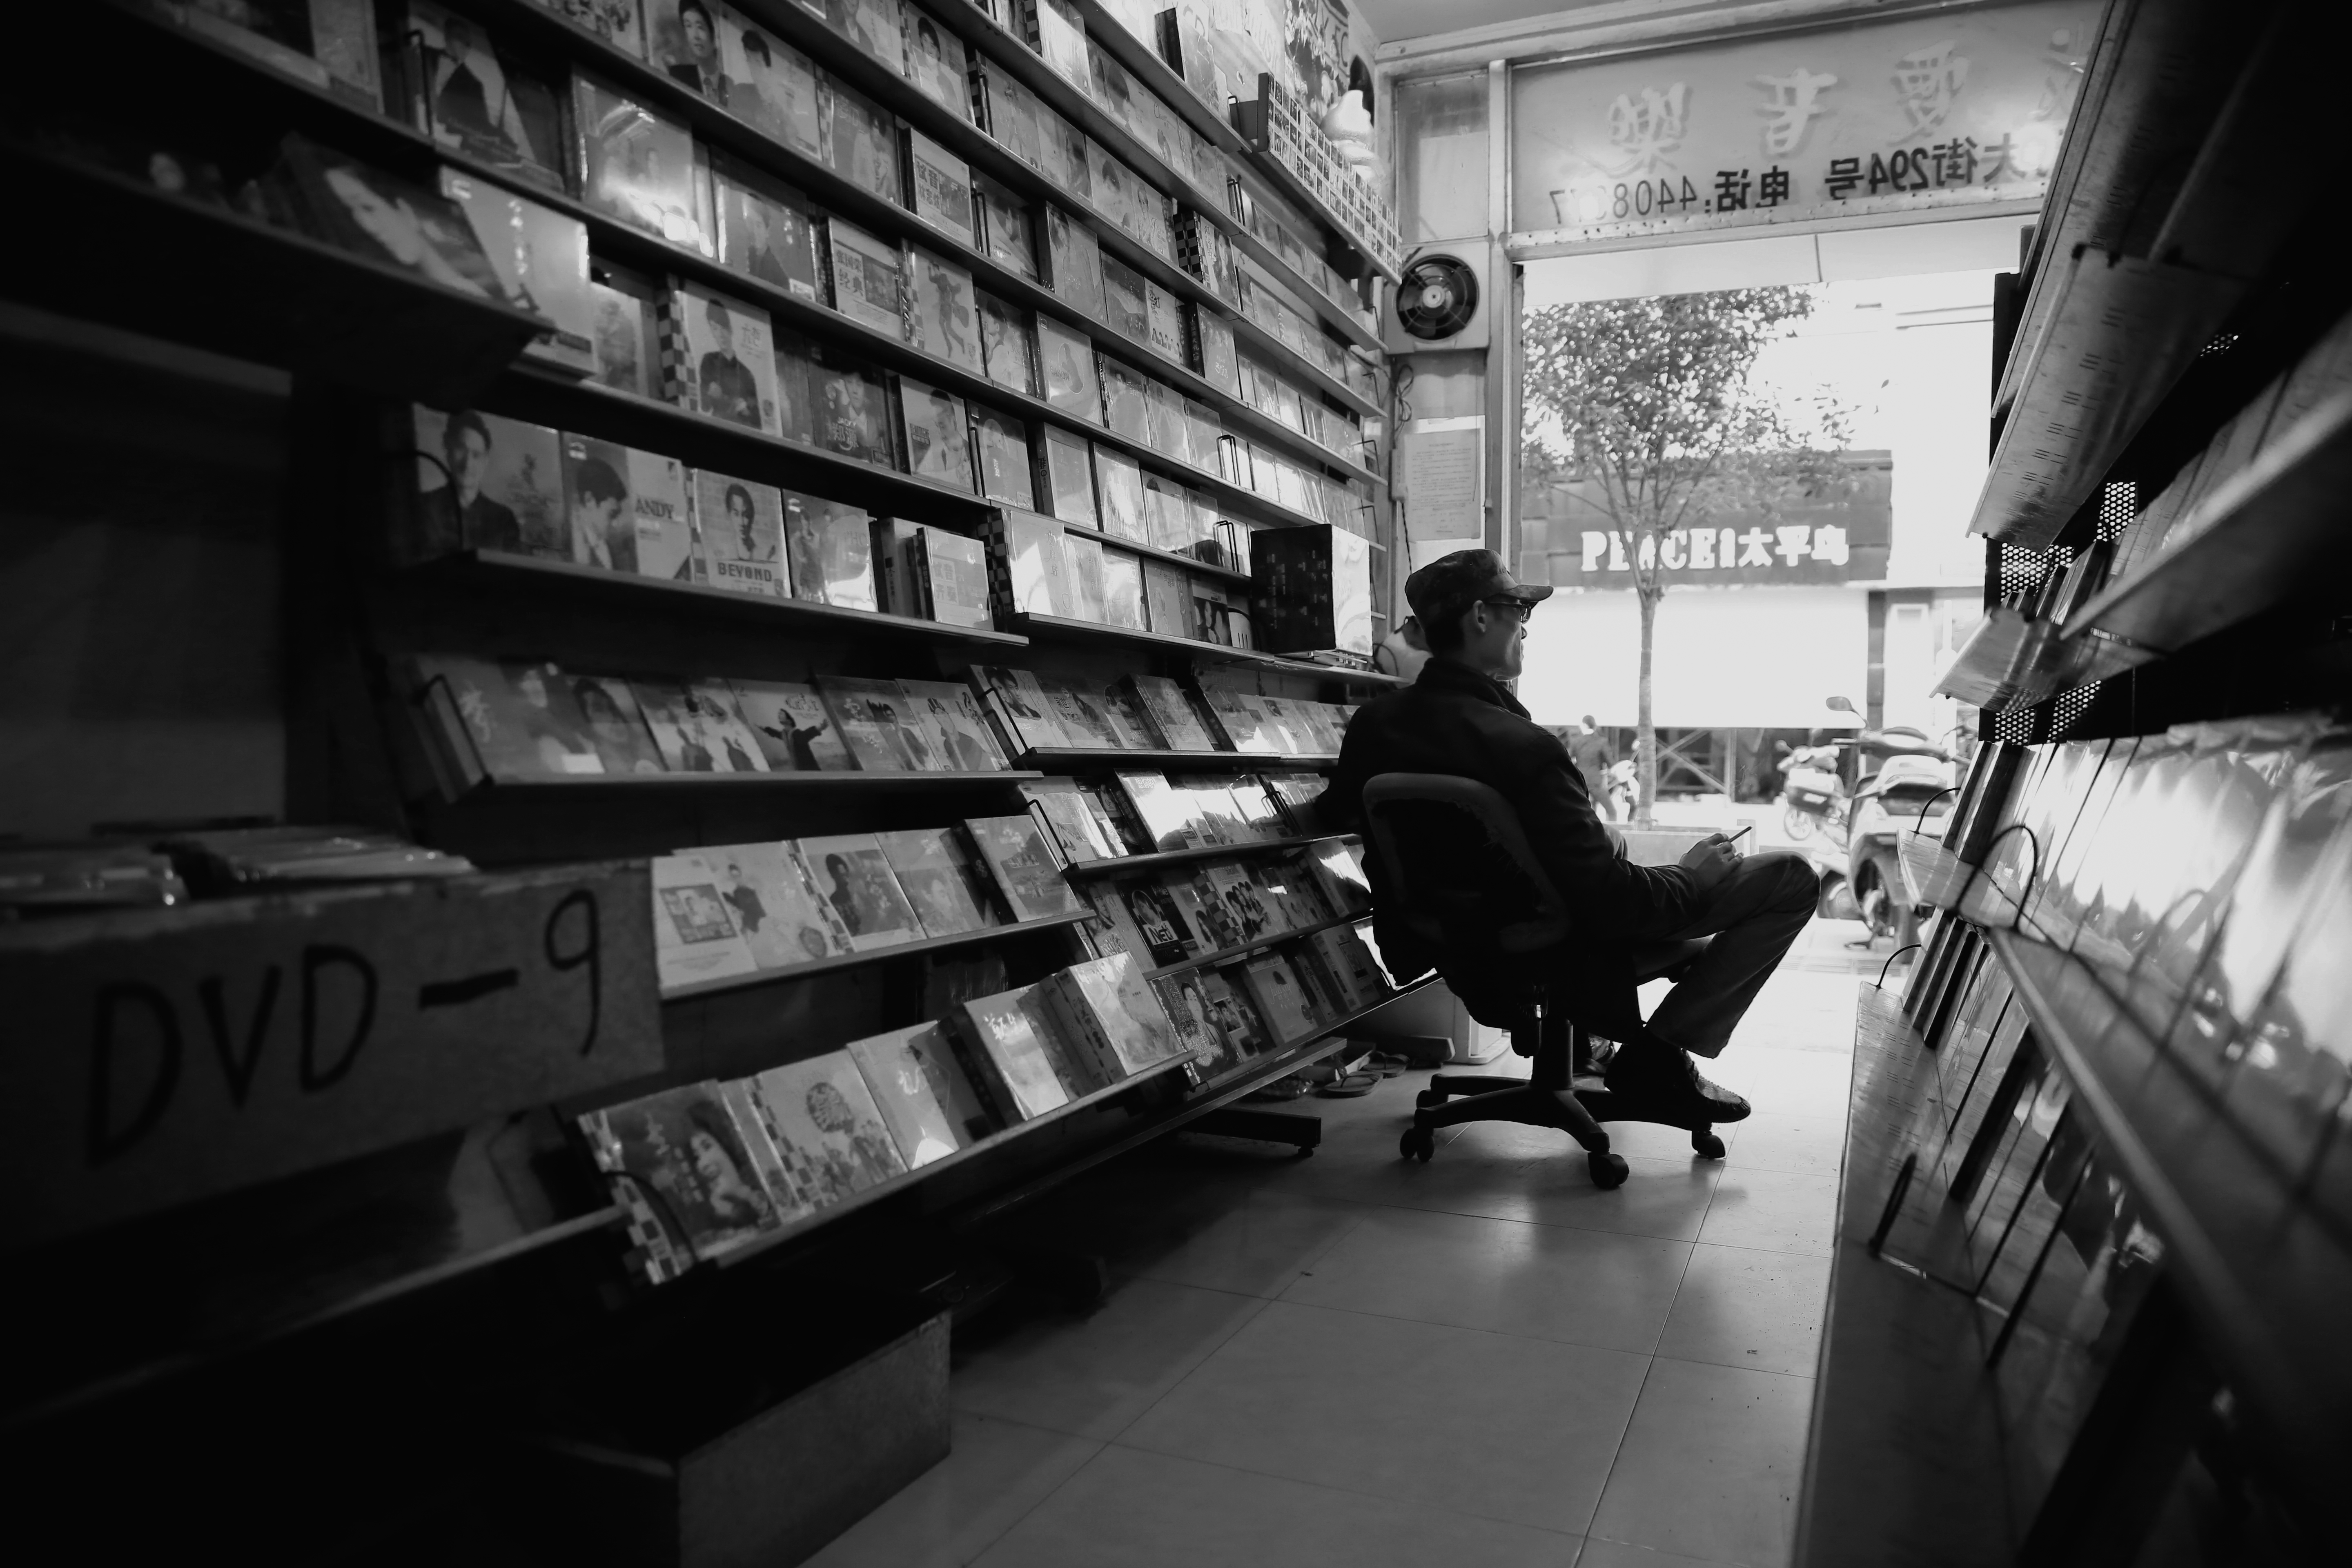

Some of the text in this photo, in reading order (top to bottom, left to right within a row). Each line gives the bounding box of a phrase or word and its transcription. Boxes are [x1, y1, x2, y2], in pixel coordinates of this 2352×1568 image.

[839, 268, 864, 297] 经典
[1050, 365, 1070, 381] EASON
[635, 497, 675, 519] ANDY
[717, 561, 773, 582] BEYOND
